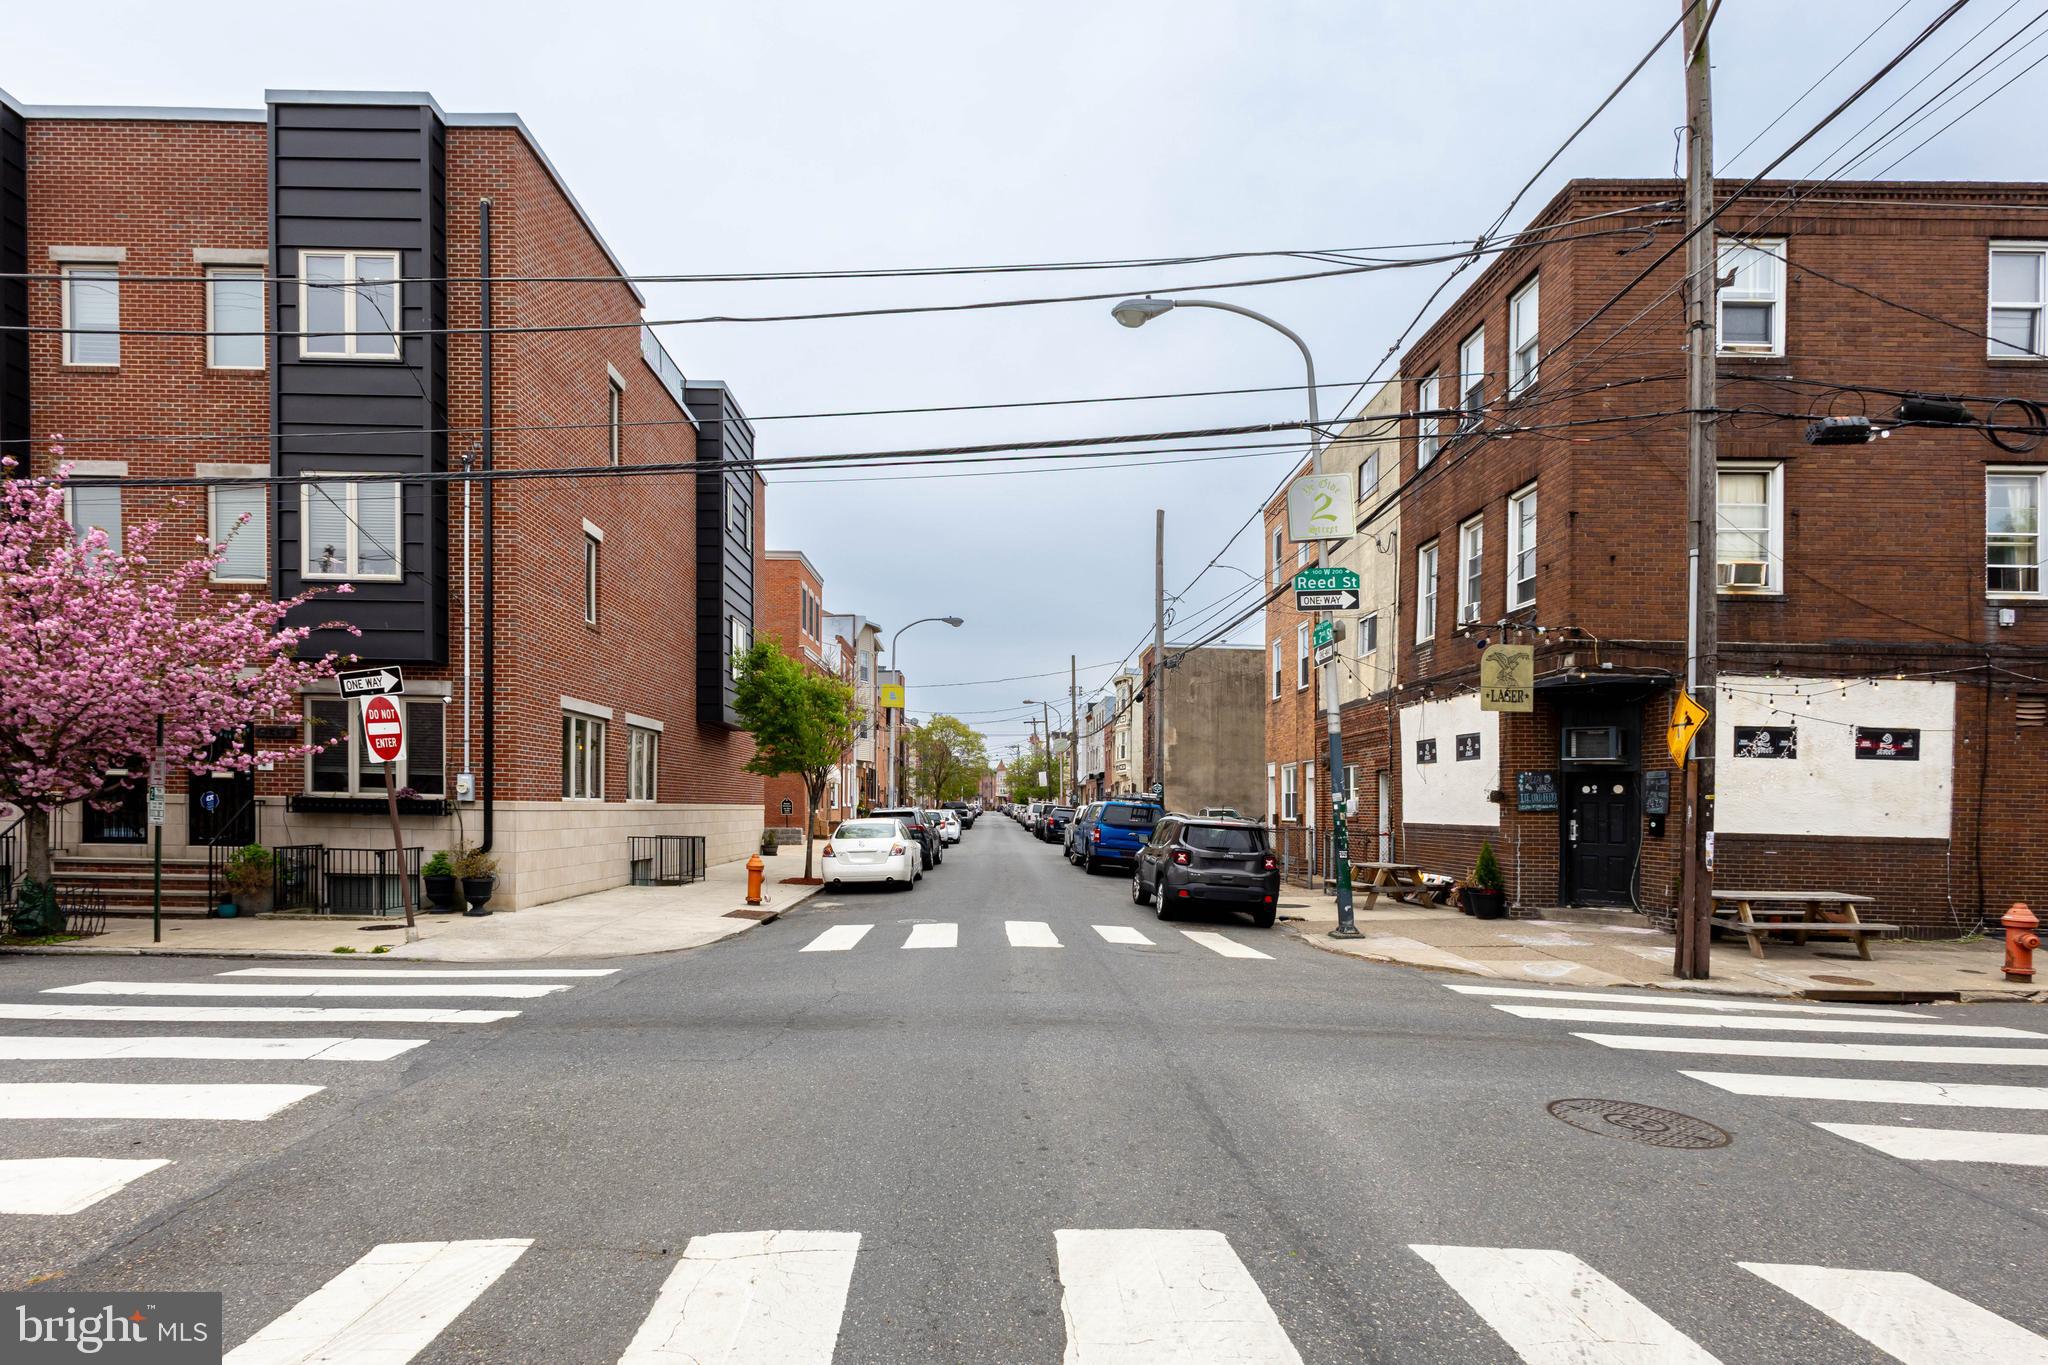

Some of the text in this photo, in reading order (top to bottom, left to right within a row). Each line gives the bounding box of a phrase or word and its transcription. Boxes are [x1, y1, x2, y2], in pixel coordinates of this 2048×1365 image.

[1312, 492, 1338, 522] 2
[1297, 576, 1358, 589] Reed St
[1303, 595, 1341, 605] ONE WAY
[345, 676, 383, 691] ONE WAY
[368, 709, 395, 720] DO NOT
[375, 737, 397, 749] ENTER
